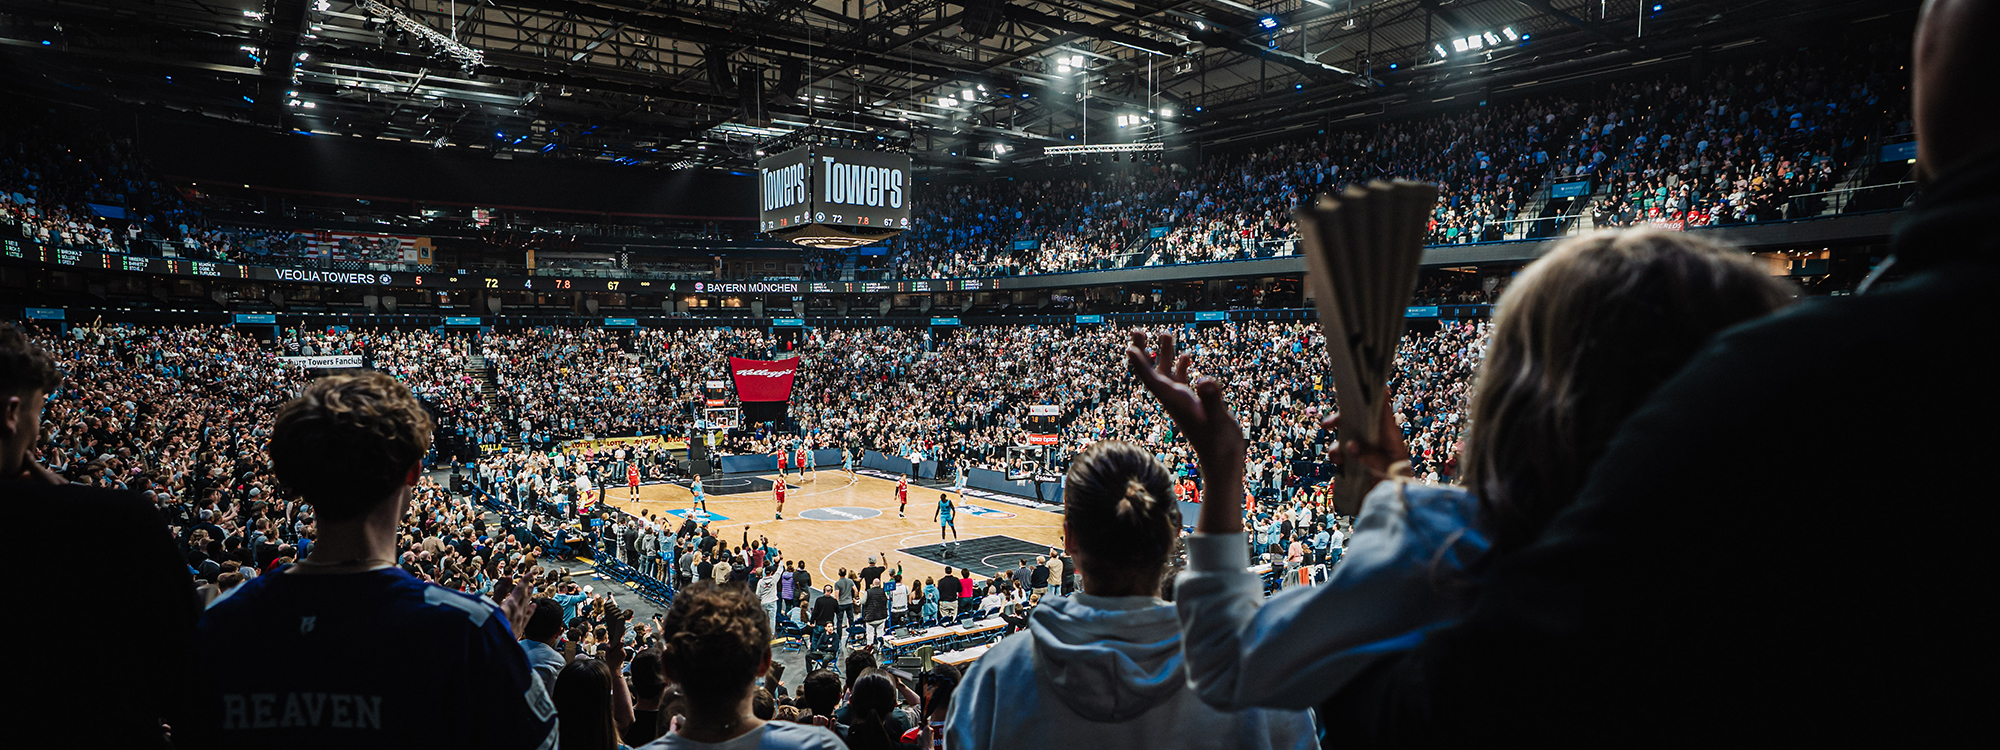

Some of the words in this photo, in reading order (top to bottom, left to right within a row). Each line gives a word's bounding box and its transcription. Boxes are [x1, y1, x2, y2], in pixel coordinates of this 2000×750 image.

[762, 162, 805, 212] Towers
[822, 156, 903, 209] Towers
[832, 214, 843, 223] 72
[857, 217, 869, 225] 7.8
[884, 218, 893, 227] 67
[275, 268, 321, 282] VEOLIA
[321, 271, 375, 284] TOWERS
[415, 276, 422, 285] 5
[485, 278, 499, 288] 72
[524, 279, 532, 289] 4
[555, 279, 571, 289] 7.8
[607, 281, 620, 291] 67
[670, 282, 676, 291] 4
[707, 283, 747, 292] BAYERN
[748, 282, 798, 292] MÜNCHEN
[335, 357, 362, 365] Fanclub
[736, 368, 794, 378] Kellogg's
